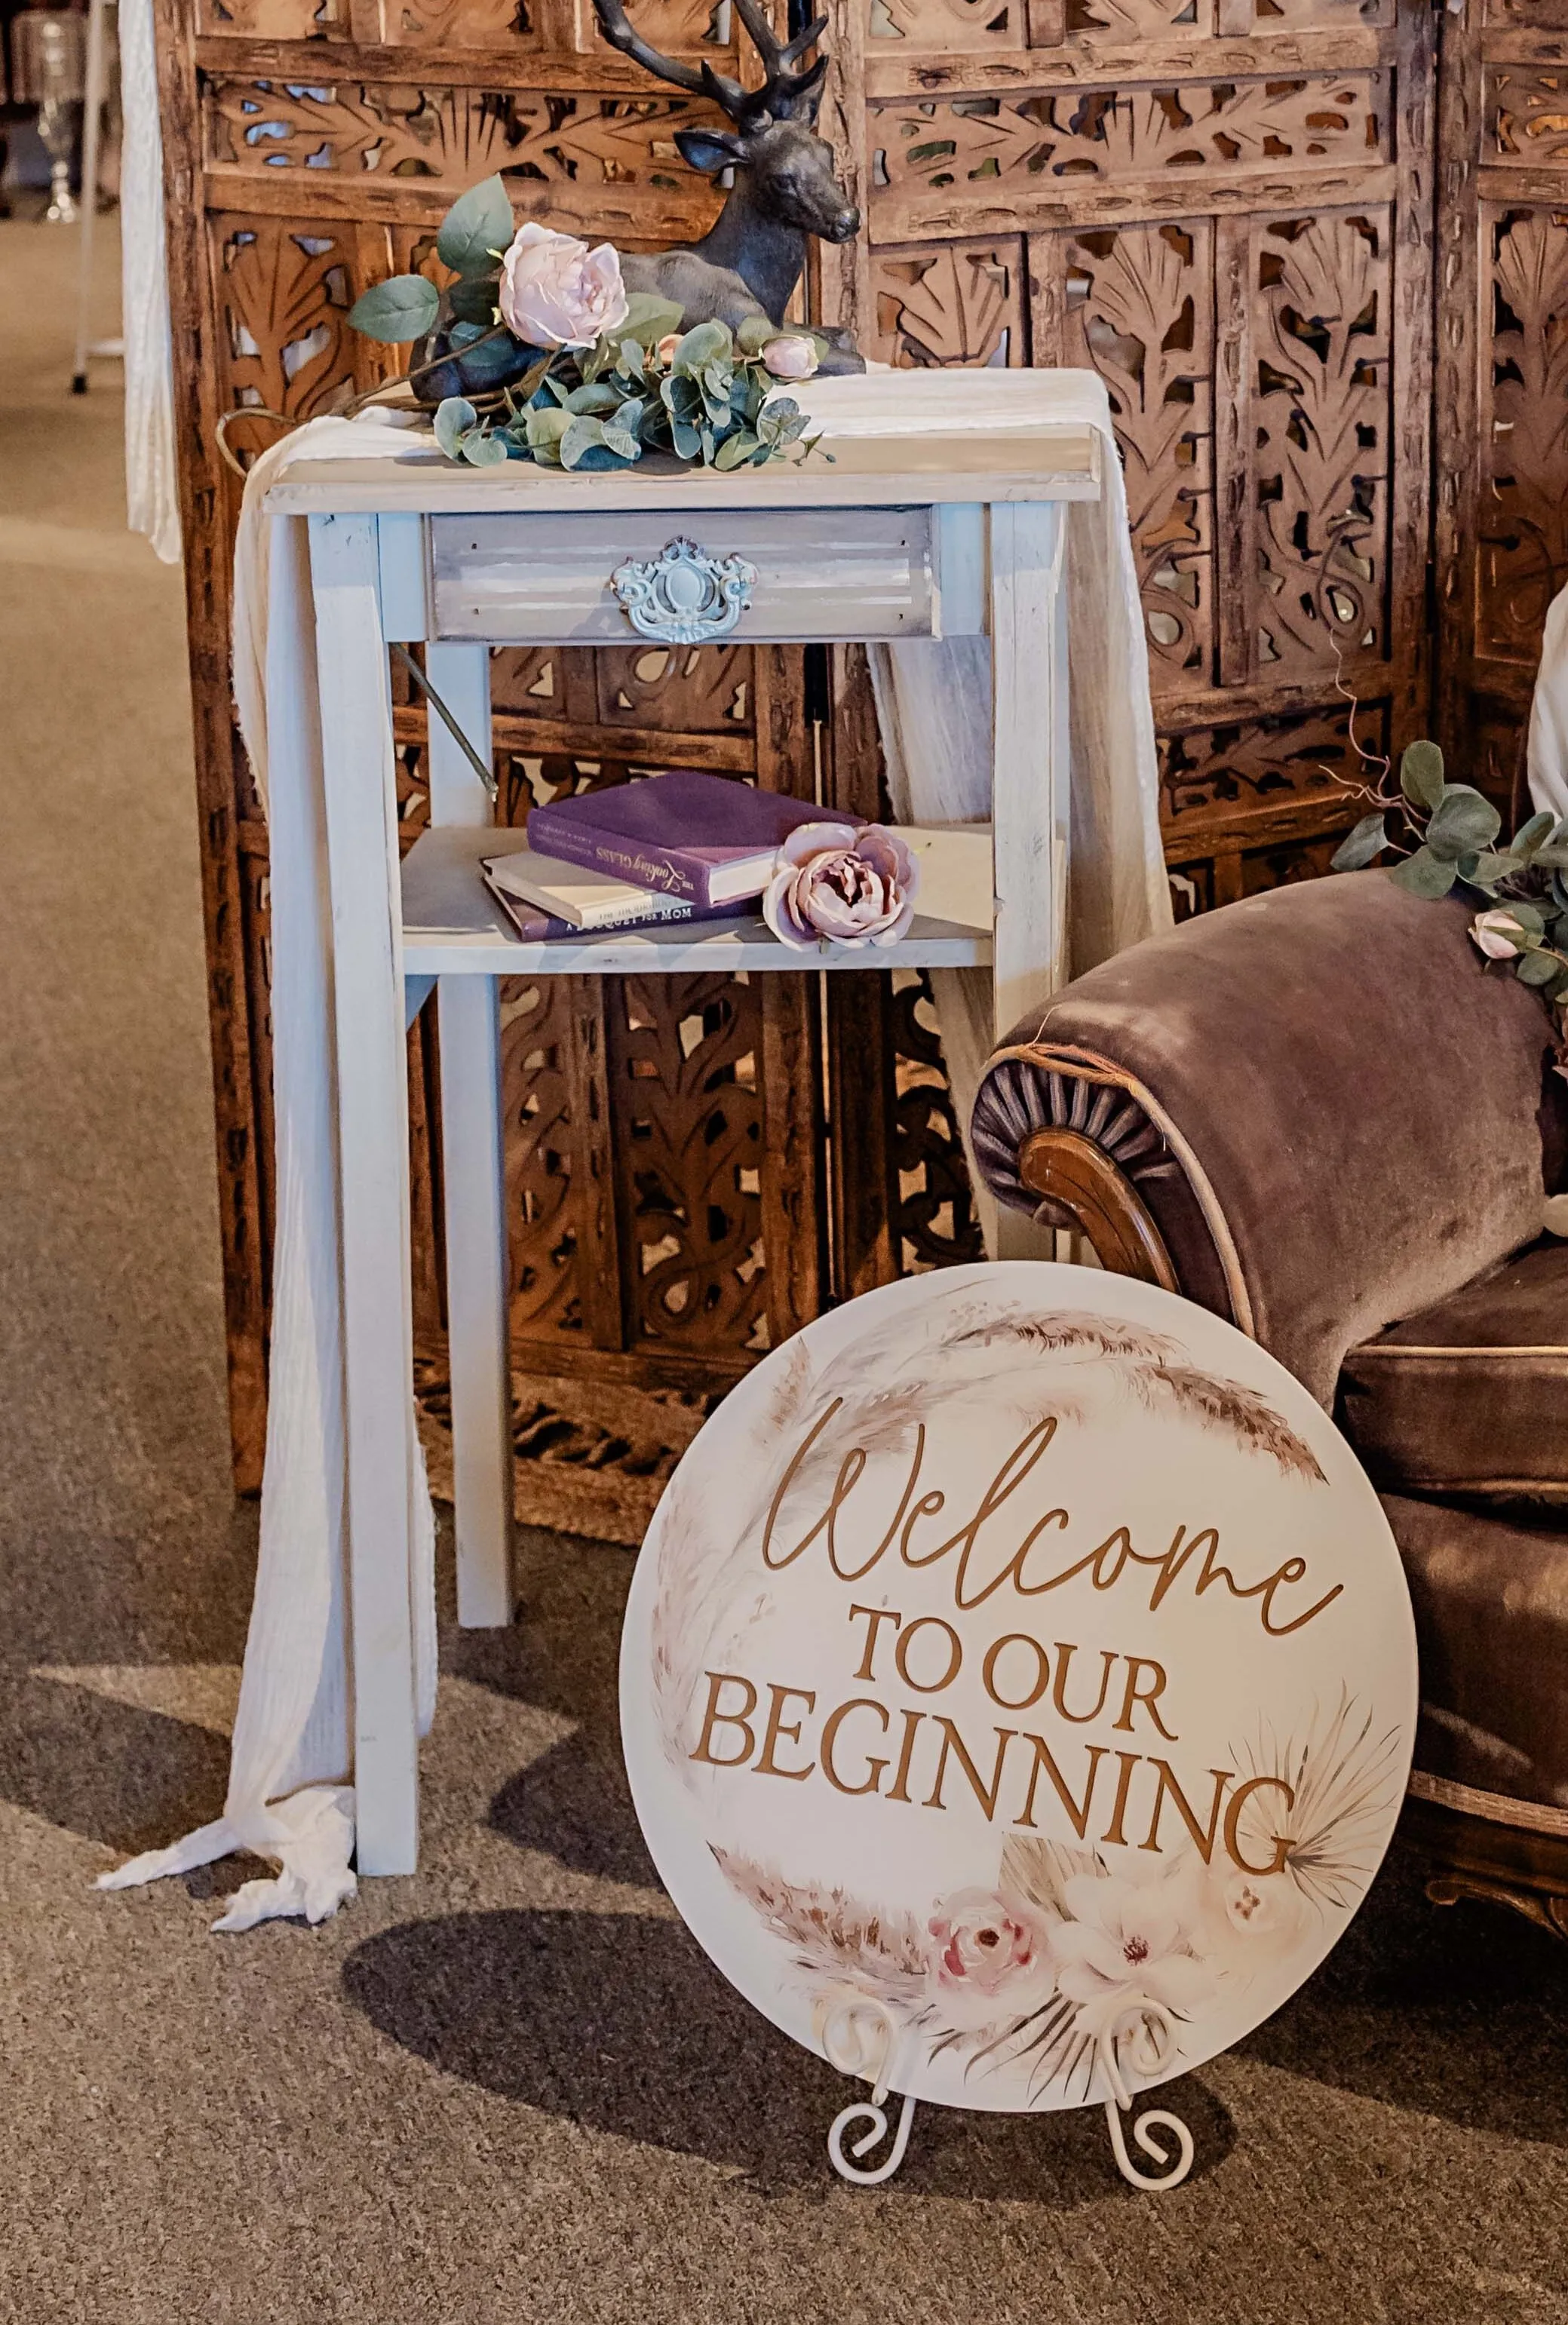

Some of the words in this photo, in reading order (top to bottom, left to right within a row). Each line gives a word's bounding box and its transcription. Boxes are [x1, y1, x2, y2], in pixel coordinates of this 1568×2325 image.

[595, 845, 632, 869] GLASS
[632, 853, 686, 893] Looking
[566, 922, 572, 931] A
[660, 907, 692, 921] MOM
[763, 1396, 1344, 1636] Welcome
[848, 1603, 963, 1694] TO
[982, 1633, 1179, 1741] OUR
[688, 1672, 1298, 1878] BEGINNING
